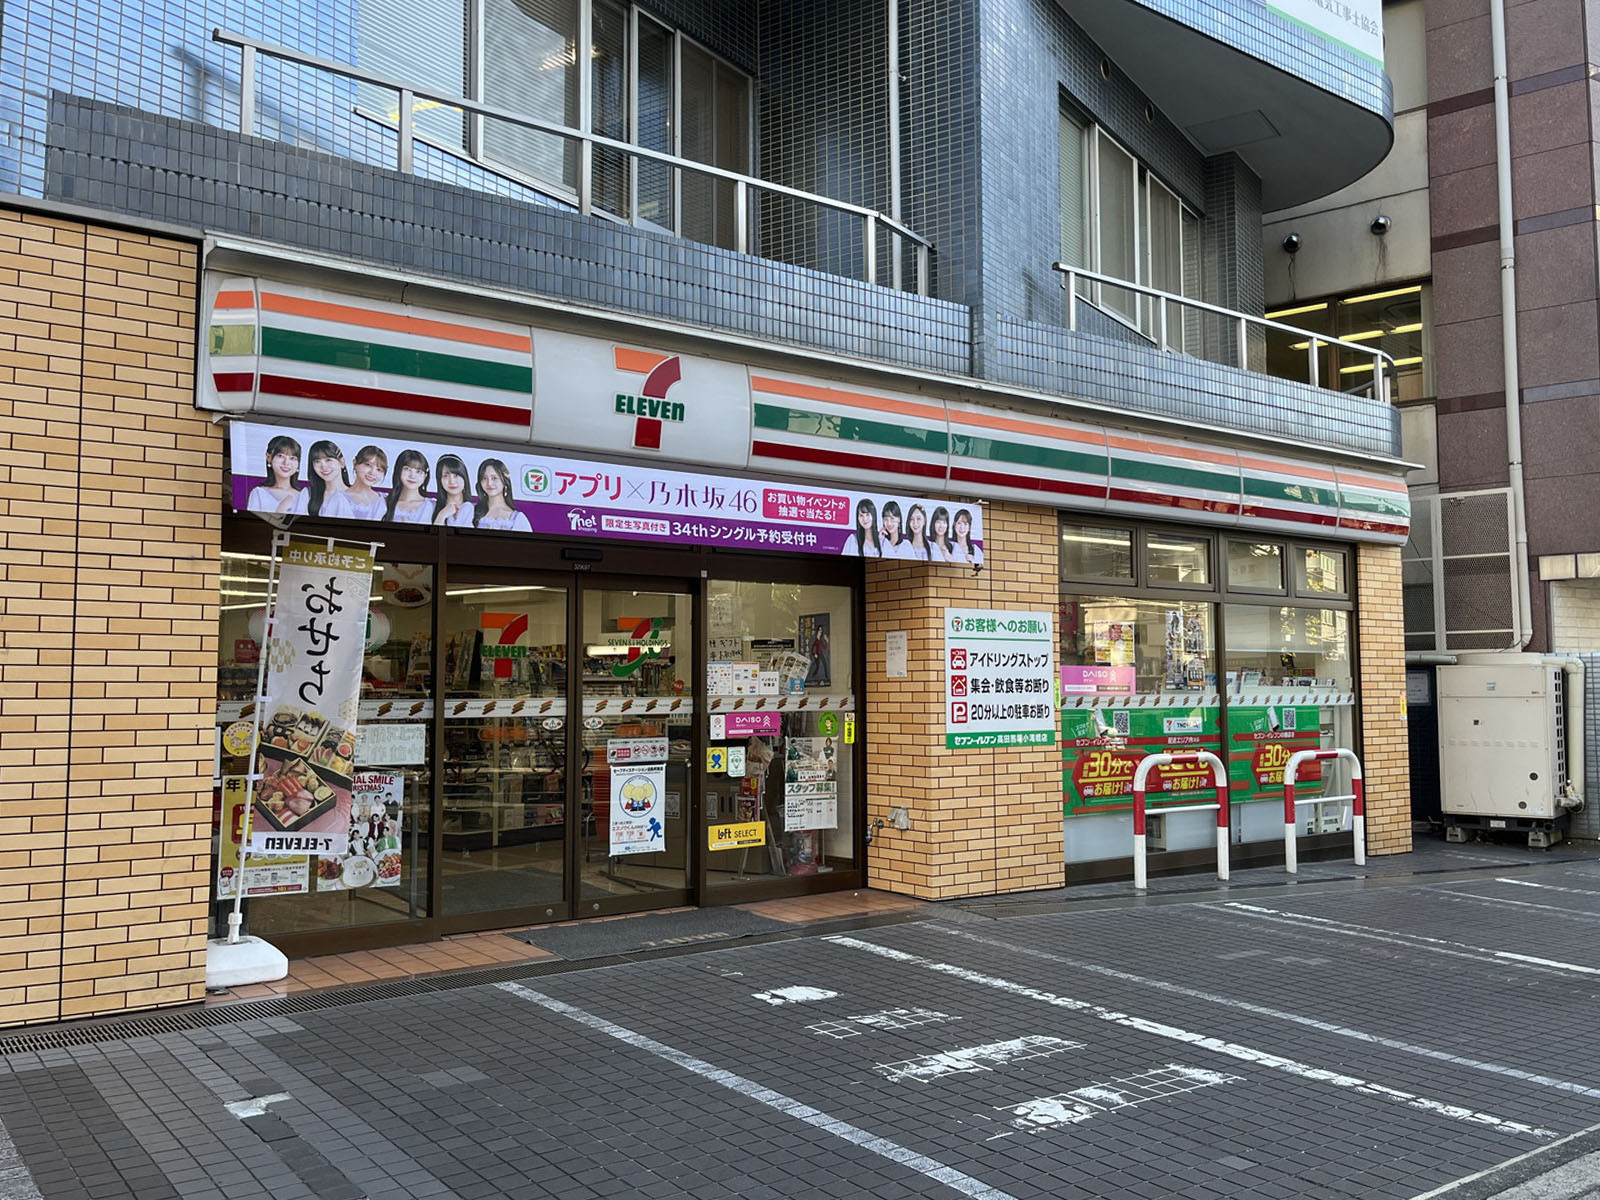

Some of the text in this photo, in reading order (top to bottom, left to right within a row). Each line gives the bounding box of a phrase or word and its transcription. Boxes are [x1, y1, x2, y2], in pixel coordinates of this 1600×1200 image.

[767, 492, 846, 510] お買い物イベントが
[605, 518, 667, 533] 限定生写真付き
[672, 523, 817, 548] 34thシングル予約受付中
[965, 618, 1047, 634] お客様へのお願い
[969, 653, 1049, 668] アイドリングストップ
[970, 678, 1050, 694] 集会・飲食等お断り
[735, 716, 761, 724] DAISO
[971, 704, 1050, 721] 20分以上の駐車お断り
[353, 775, 395, 785] IAL SMILE
[787, 782, 832, 793] スタッフ募集
[1094, 781, 1124, 796] お届け!
[734, 829, 757, 838] SELECT
